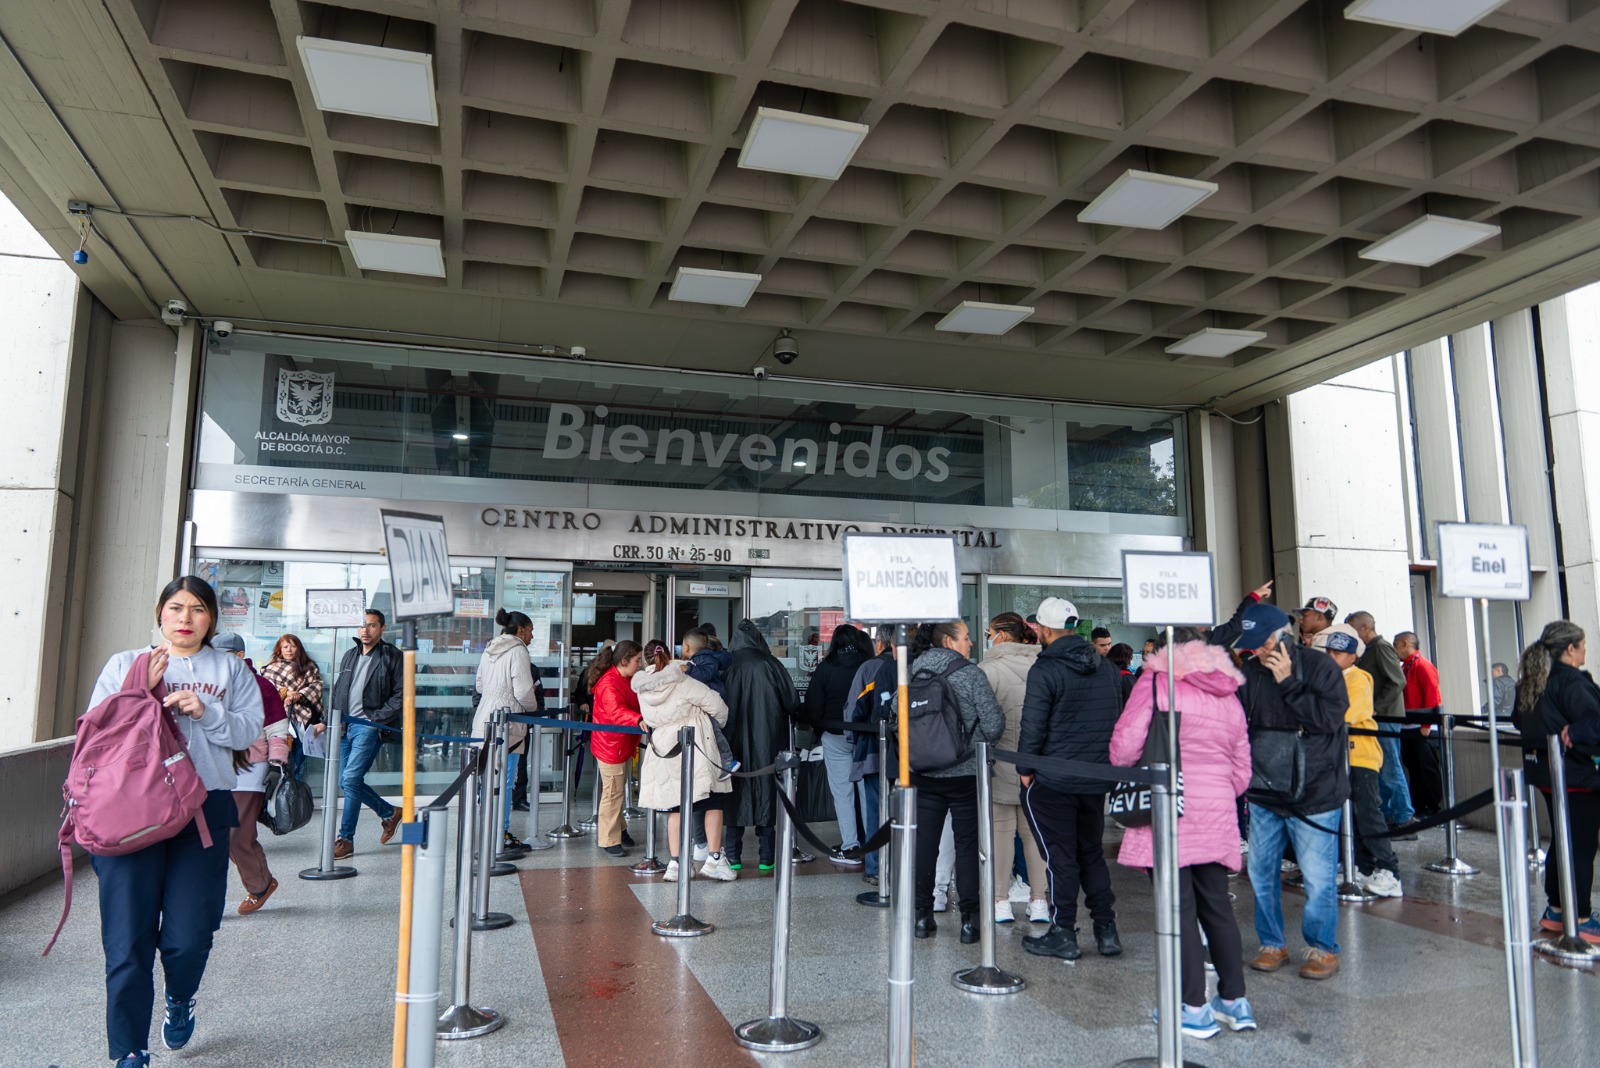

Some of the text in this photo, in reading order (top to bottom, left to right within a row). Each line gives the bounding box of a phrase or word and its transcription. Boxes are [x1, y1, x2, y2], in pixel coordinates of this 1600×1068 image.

[254, 431, 350, 445] ALCALDÍA MAYOR
[542, 403, 952, 483] Bienvenidos
[260, 442, 347, 455] DE BOGOTÁ D.C.
[234, 475, 367, 490] SECRETARÍA GENERAL
[481, 508, 601, 530] CENTRO
[1478, 542, 1498, 550] FILA
[690, 547, 732, 562] 25-90
[889, 556, 913, 564] FILA
[392, 528, 451, 603] DIAN
[1471, 555, 1507, 573] Enel
[856, 566, 949, 588] PLANEACIÓN
[1139, 582, 1199, 599] SISBEN
[312, 603, 359, 615] SALIDA
